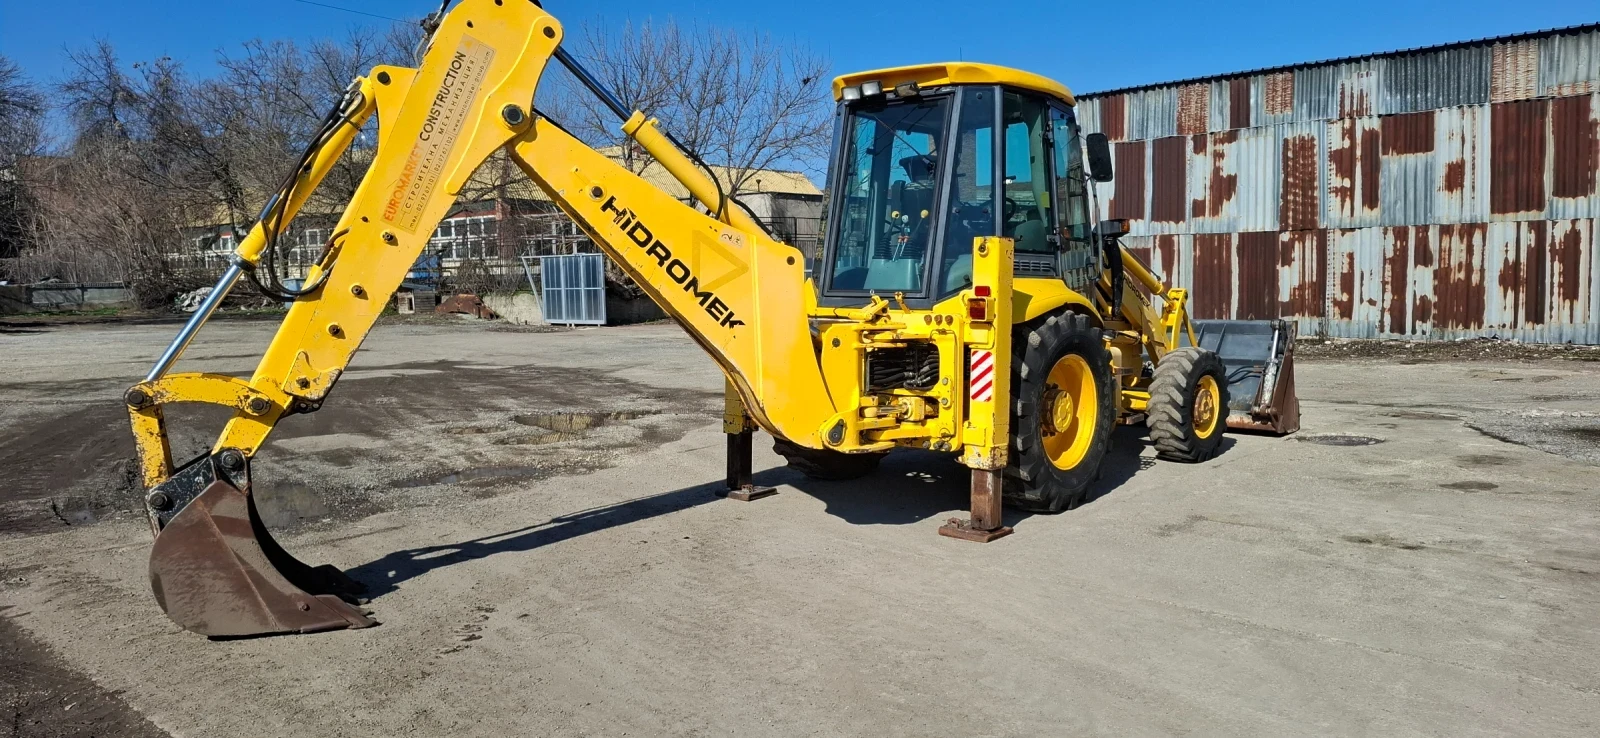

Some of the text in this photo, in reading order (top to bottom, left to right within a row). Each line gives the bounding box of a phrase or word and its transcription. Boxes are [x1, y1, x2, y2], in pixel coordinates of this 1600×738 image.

[384, 51, 466, 222] EUROMARKET CONSTRUCTION
[405, 60, 475, 208] СТРОИТЕЛНА МЕХАНИЗАЦИЯ
